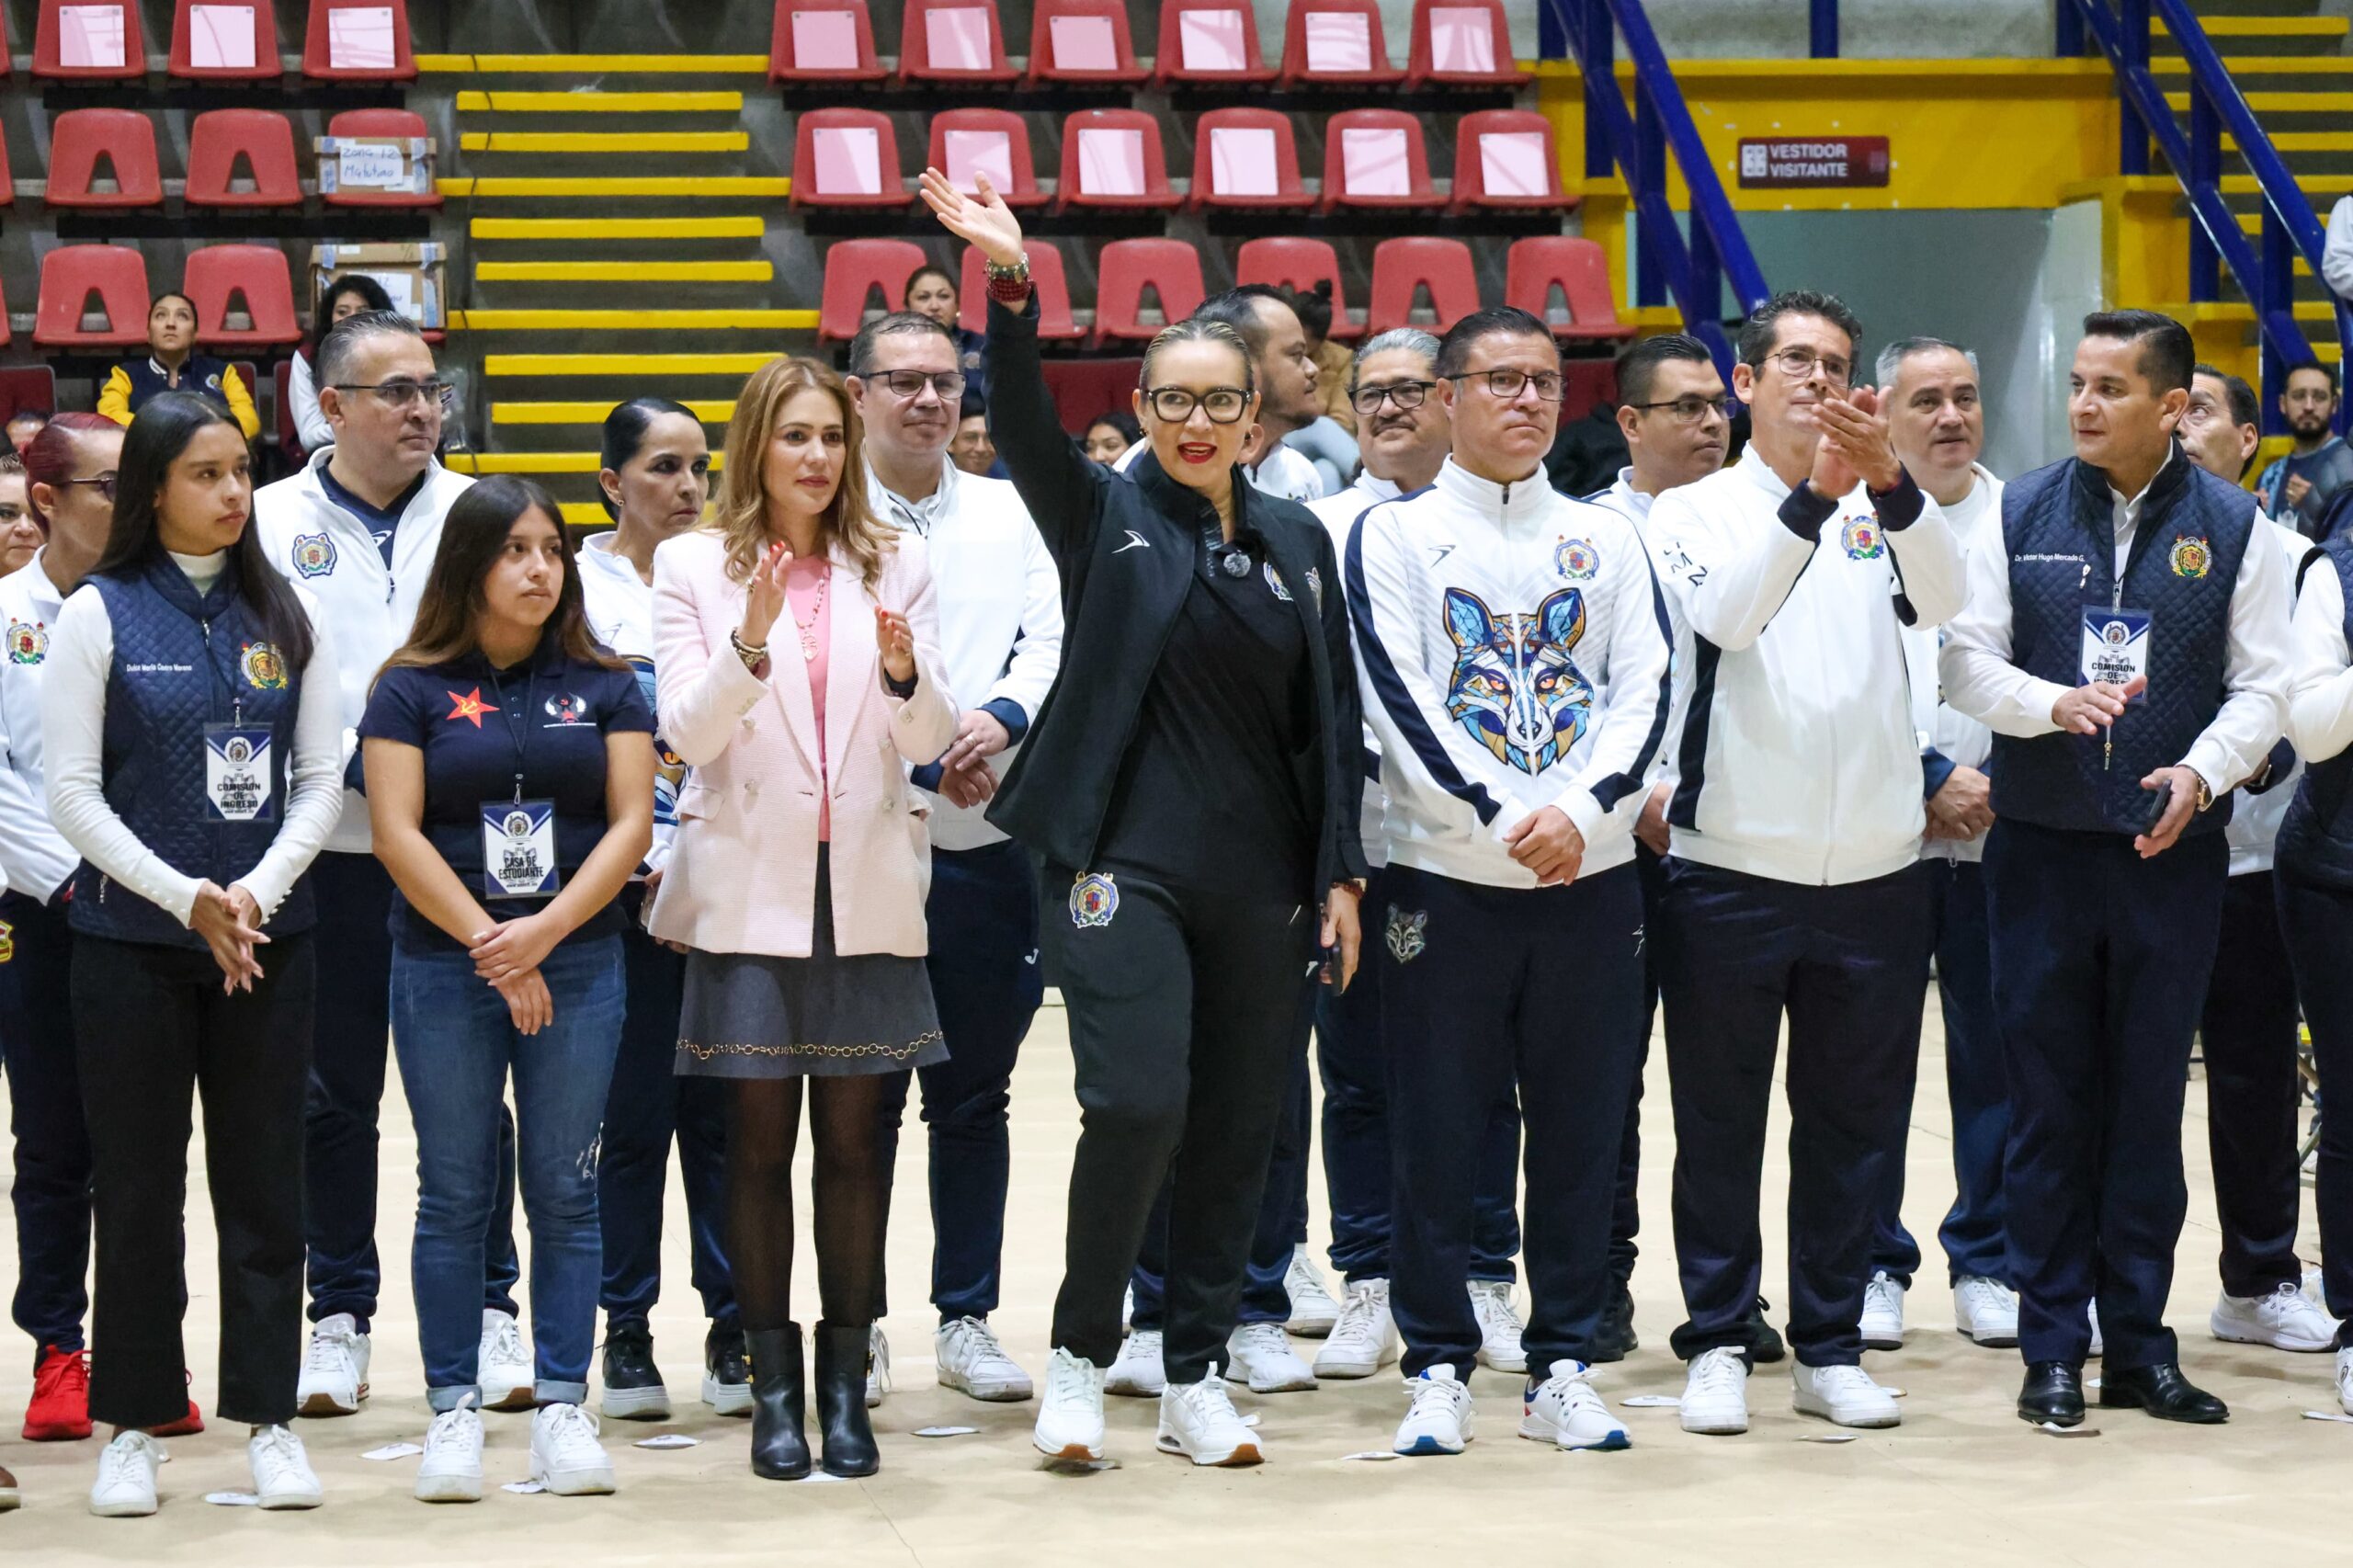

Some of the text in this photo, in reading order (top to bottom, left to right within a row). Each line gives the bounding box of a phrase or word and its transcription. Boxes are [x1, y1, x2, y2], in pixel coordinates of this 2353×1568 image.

[1769, 143, 1847, 158] VESTIDOR
[1770, 162, 1848, 176] VISITANTE
[2039, 553, 2053, 562] Hugo
[505, 856, 537, 868] CASA DE
[498, 867, 544, 880] ESTUDIANTE
